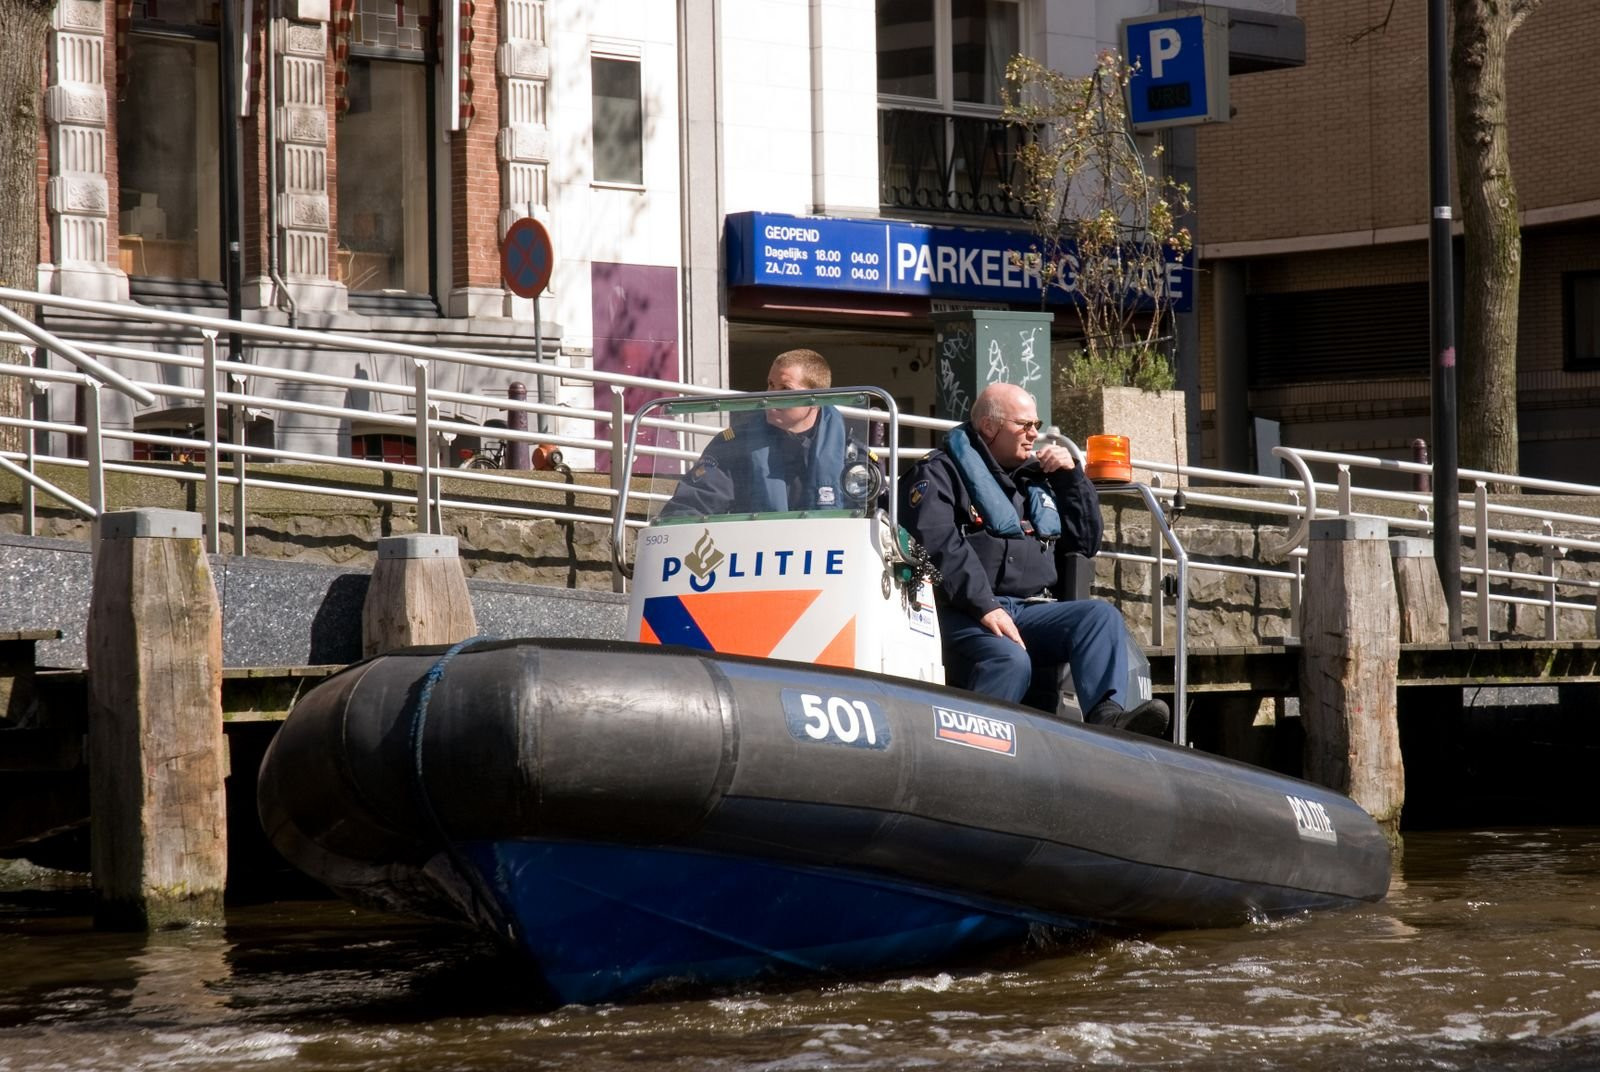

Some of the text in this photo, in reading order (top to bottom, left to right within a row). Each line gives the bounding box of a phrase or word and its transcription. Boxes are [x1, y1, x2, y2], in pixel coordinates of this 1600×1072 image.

[1149, 28, 1182, 79] P
[765, 225, 820, 242] GEOPEND
[764, 245, 879, 265] Dagelijks 18.00 04.00
[897, 242, 1043, 289] PARKEER
[815, 265, 841, 278] 10.00
[851, 267, 879, 280] 04.00
[645, 534, 669, 546] 5903
[662, 550, 845, 592] POLITIE
[801, 693, 876, 745] 501
[938, 709, 1012, 741] DUARRY
